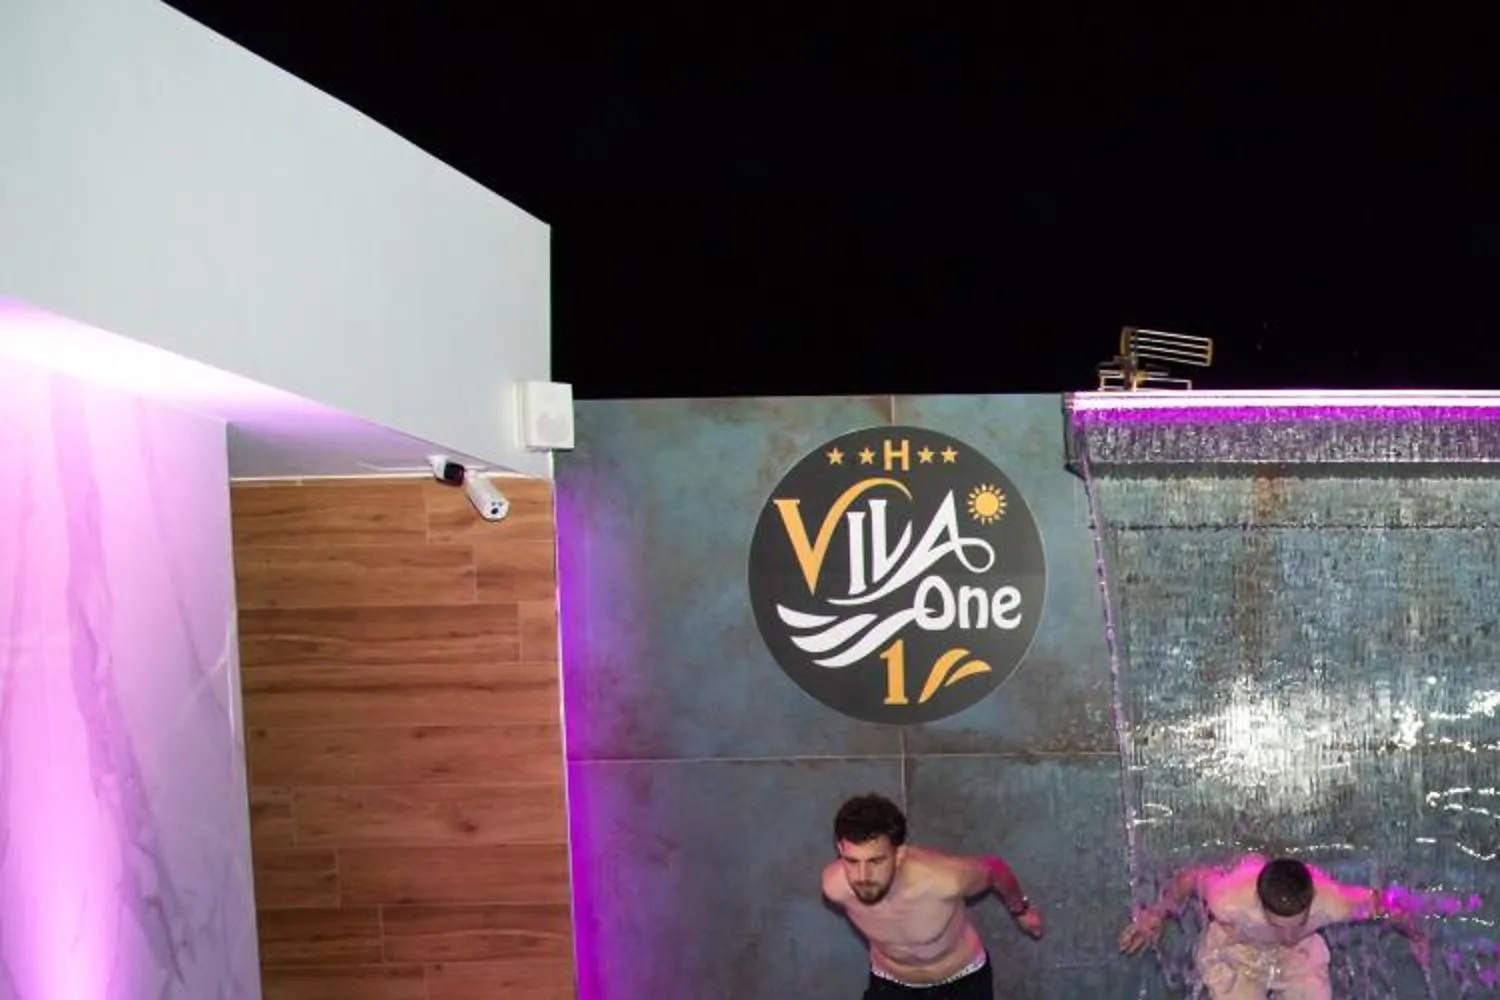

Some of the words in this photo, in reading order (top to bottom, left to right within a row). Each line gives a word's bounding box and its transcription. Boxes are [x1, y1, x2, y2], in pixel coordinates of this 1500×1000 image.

[884, 439, 909, 471] H
[914, 575, 1022, 631] One
[880, 639, 909, 705] 1
